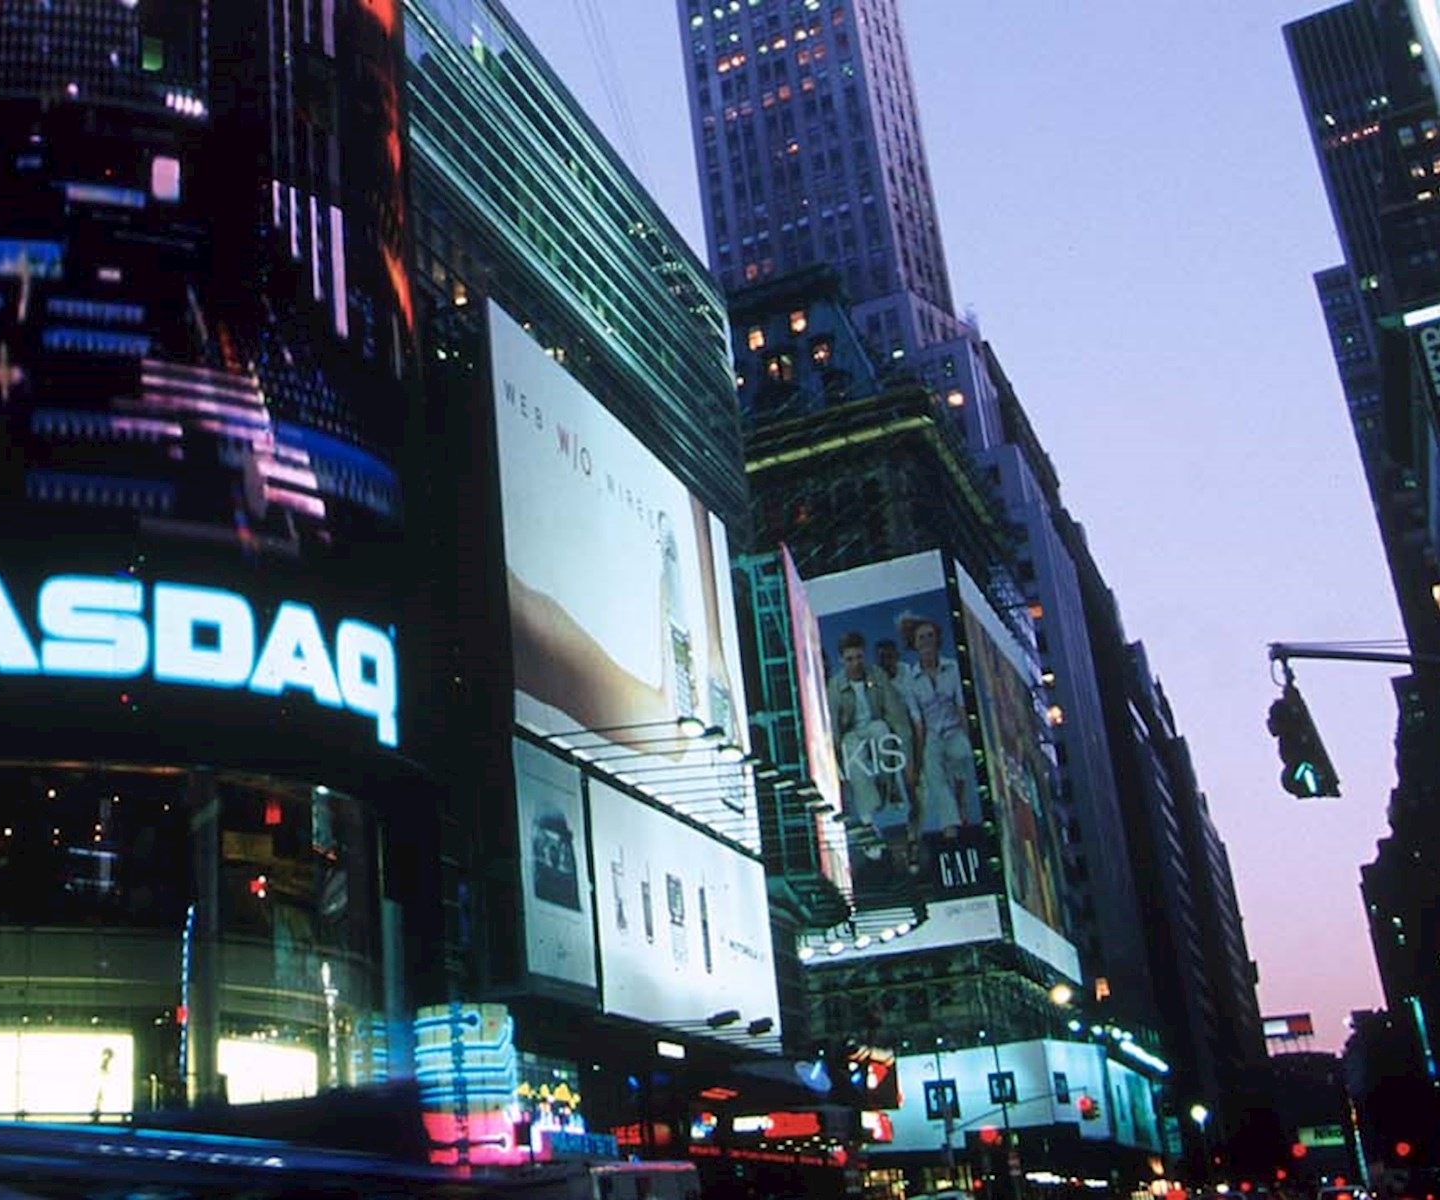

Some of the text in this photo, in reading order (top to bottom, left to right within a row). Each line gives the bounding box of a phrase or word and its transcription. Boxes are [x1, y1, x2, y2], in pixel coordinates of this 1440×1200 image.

[503, 379, 544, 431] WEB
[837, 733, 907, 782] KIS
[939, 847, 979, 888] GAP
